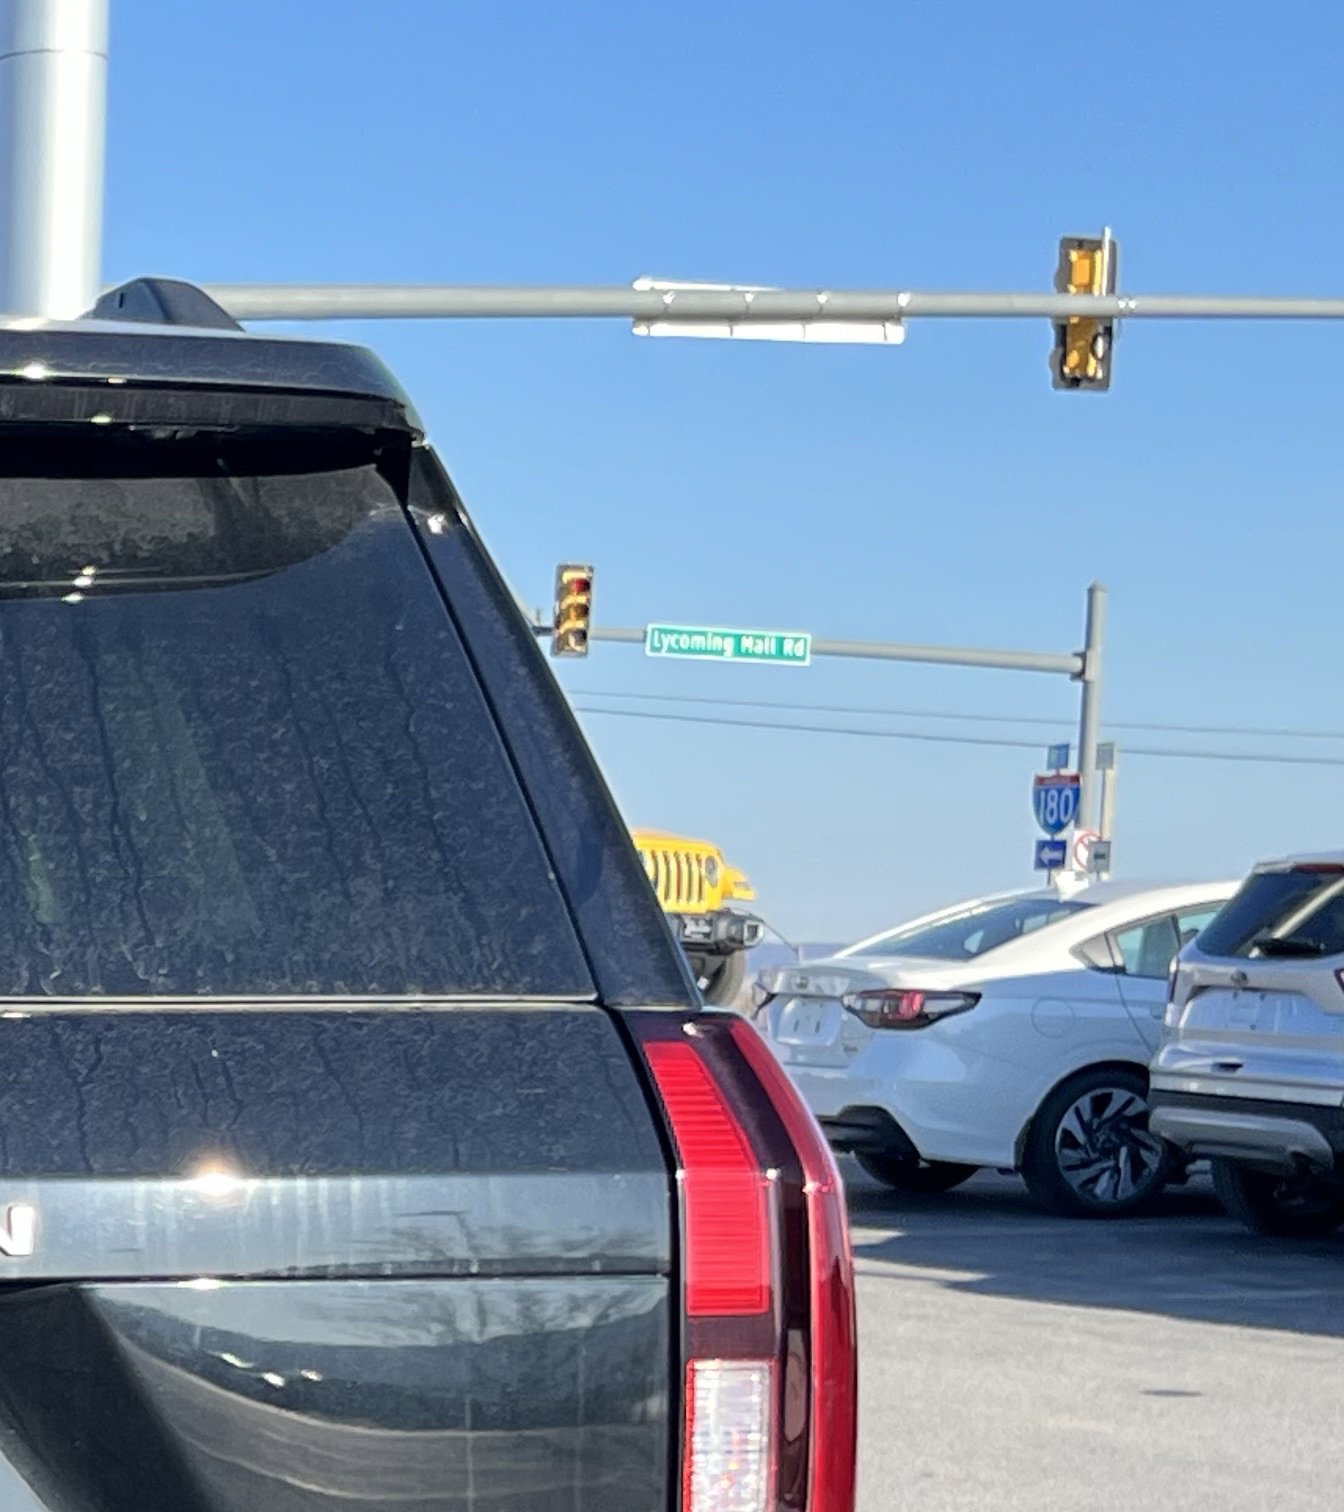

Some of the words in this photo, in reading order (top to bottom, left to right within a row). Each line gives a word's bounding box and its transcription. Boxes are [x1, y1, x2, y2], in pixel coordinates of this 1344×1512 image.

[653, 630, 735, 657] Lycoming
[740, 634, 777, 656] Mall
[783, 637, 805, 657] Rd
[1039, 788, 1075, 825] 180
